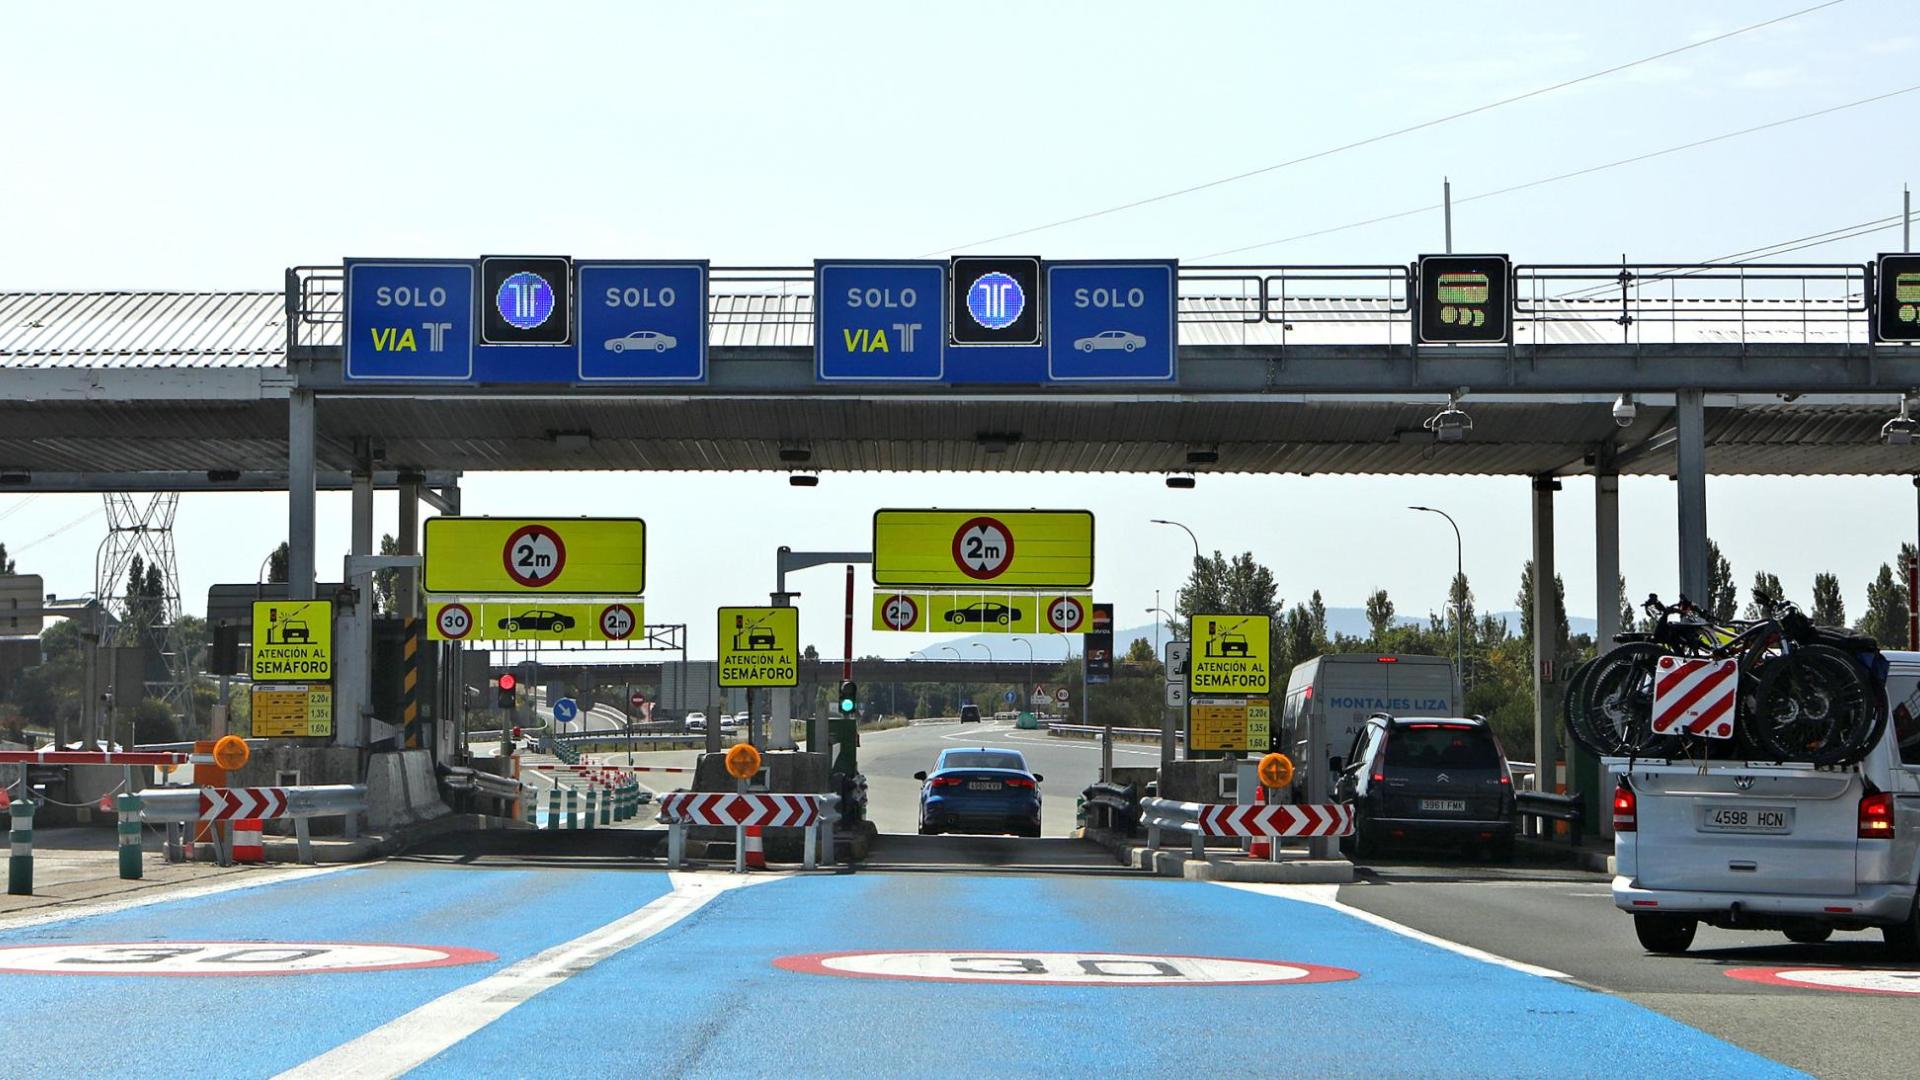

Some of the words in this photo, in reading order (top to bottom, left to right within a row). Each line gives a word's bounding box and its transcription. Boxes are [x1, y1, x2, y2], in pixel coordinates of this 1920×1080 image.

[376, 287, 446, 307] SOLO
[605, 287, 676, 308] SOLO
[847, 288, 917, 308] SOLO
[1074, 287, 1145, 308] SOLO
[370, 327, 417, 352] VIA
[843, 328, 889, 353] VIA
[444, 615, 465, 628] 30
[1055, 608, 1076, 621] 30
[257, 646, 308, 658] ATENCIÓN
[313, 649, 326, 658] AL
[256, 659, 328, 673] SEMÁFORO
[779, 655, 792, 665] AL
[1252, 663, 1265, 672] AL
[722, 665, 794, 680] SEMÁFORO
[1195, 672, 1266, 687] SEMÁFORO
[1331, 697, 1409, 710] MONTAJES
[1414, 699, 1448, 711] LIZA
[1715, 810, 1748, 825] 4598
[1757, 812, 1784, 826] HCN
[56, 947, 333, 964] 30
[950, 956, 1185, 977] 30
